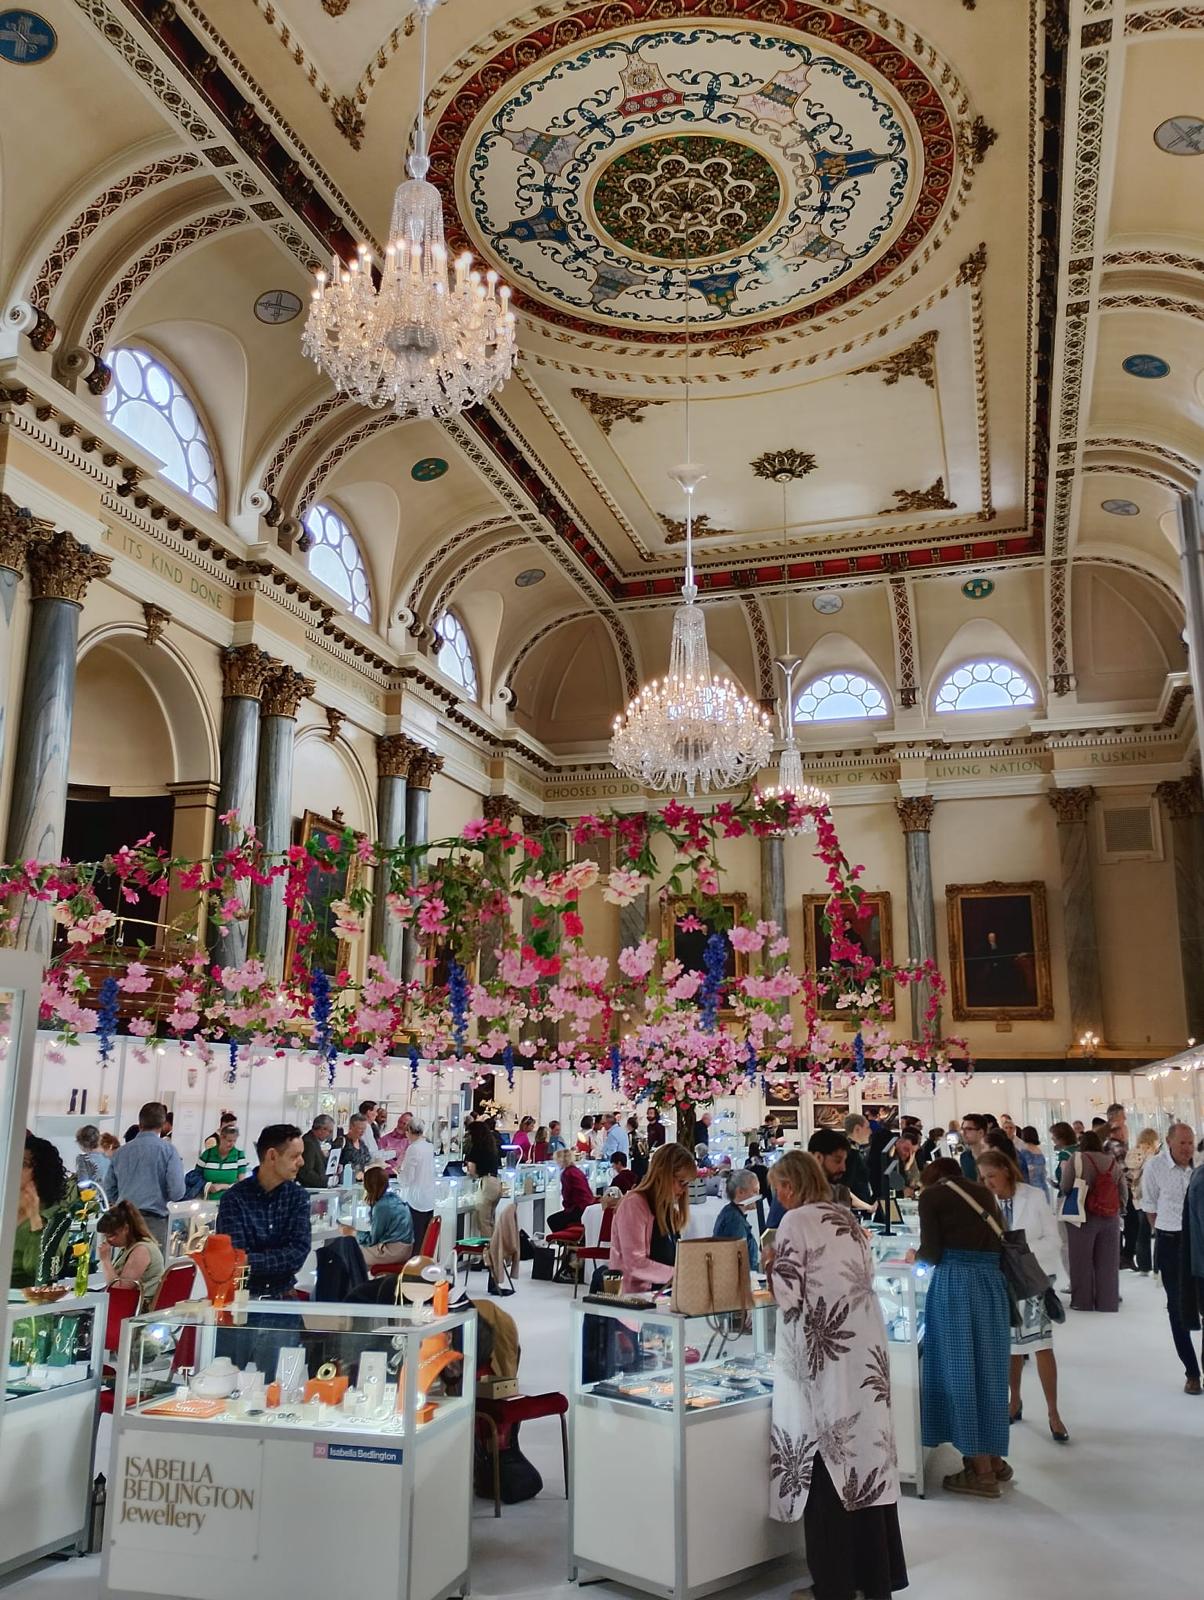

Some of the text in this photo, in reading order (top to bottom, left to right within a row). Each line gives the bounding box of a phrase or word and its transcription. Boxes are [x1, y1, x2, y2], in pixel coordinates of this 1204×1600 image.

[122, 535, 143, 560] ITS
[151, 551, 183, 584] KIND
[190, 577, 223, 610] DONE
[808, 769, 896, 786] THAT OF ANY
[936, 760, 1043, 778] LIVING NATION
[545, 783, 640, 798] CHOOSES TO DO
[329, 1447, 397, 1461] Isabella Bedlington
[125, 1456, 214, 1484] ISABELLA
[123, 1478, 255, 1511] BEDLINGTON
[119, 1500, 207, 1536] Jewellery
